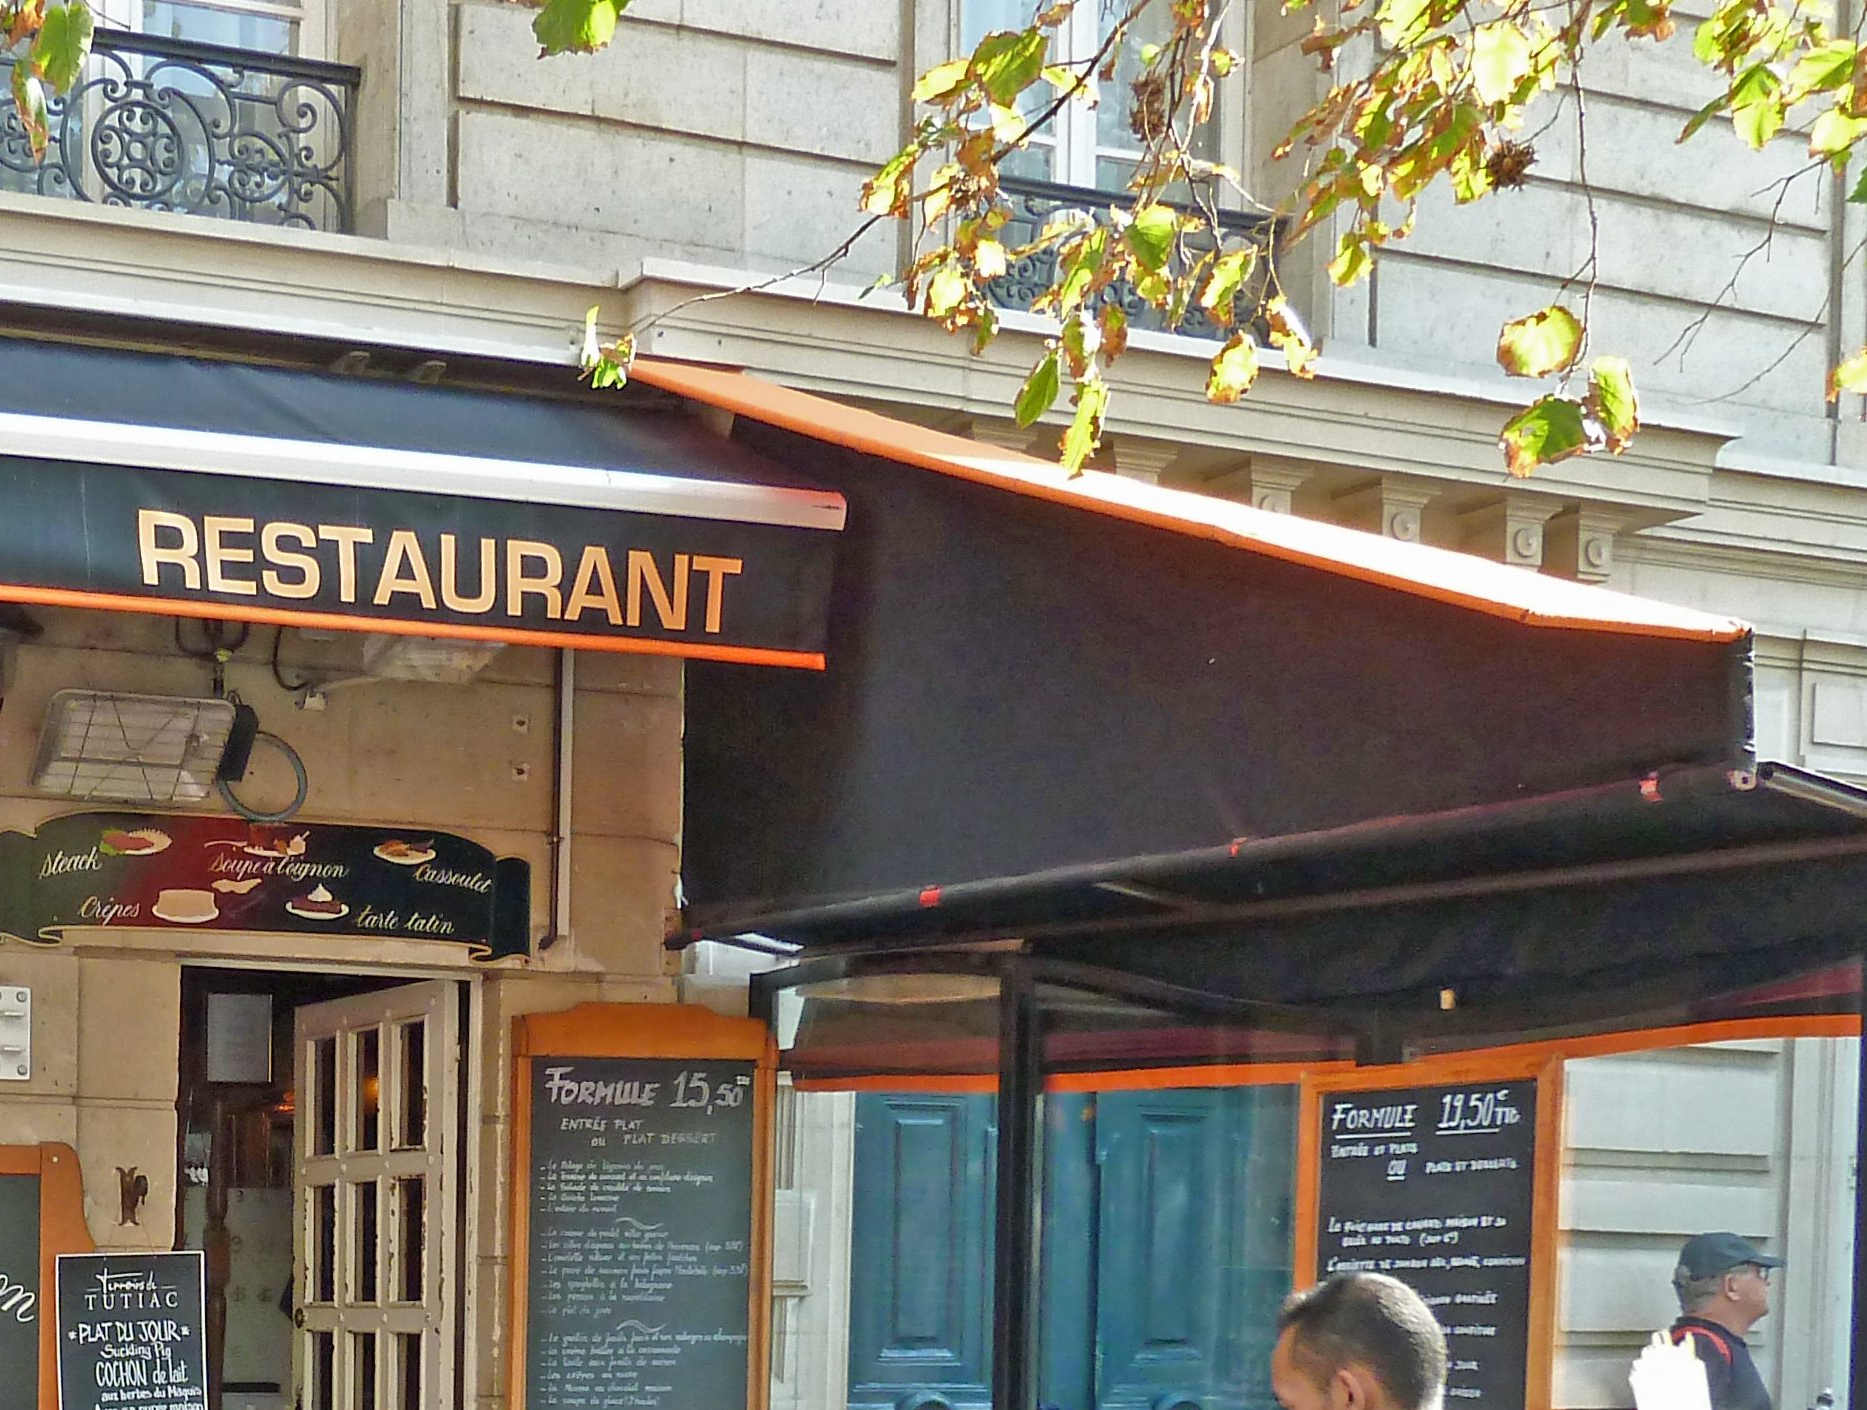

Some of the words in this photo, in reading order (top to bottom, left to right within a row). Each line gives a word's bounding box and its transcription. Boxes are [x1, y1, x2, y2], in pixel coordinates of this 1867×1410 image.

[137, 508, 743, 634] RESTAURANT
[414, 864, 493, 894] Cassoulet
[1332, 1104, 1418, 1130] FORMULE
[1387, 1159, 1407, 1176] OU
[84, 1291, 178, 1311] TUTIAC
[78, 1322, 113, 1345] PLAT
[116, 1322, 134, 1343] DU
[137, 1320, 182, 1343] JOUR
[100, 1343, 152, 1360] Suckling
[151, 1341, 172, 1360] Pig
[95, 1359, 147, 1388] COCHON
[152, 1358, 168, 1385] de
[168, 1358, 189, 1385] lait
